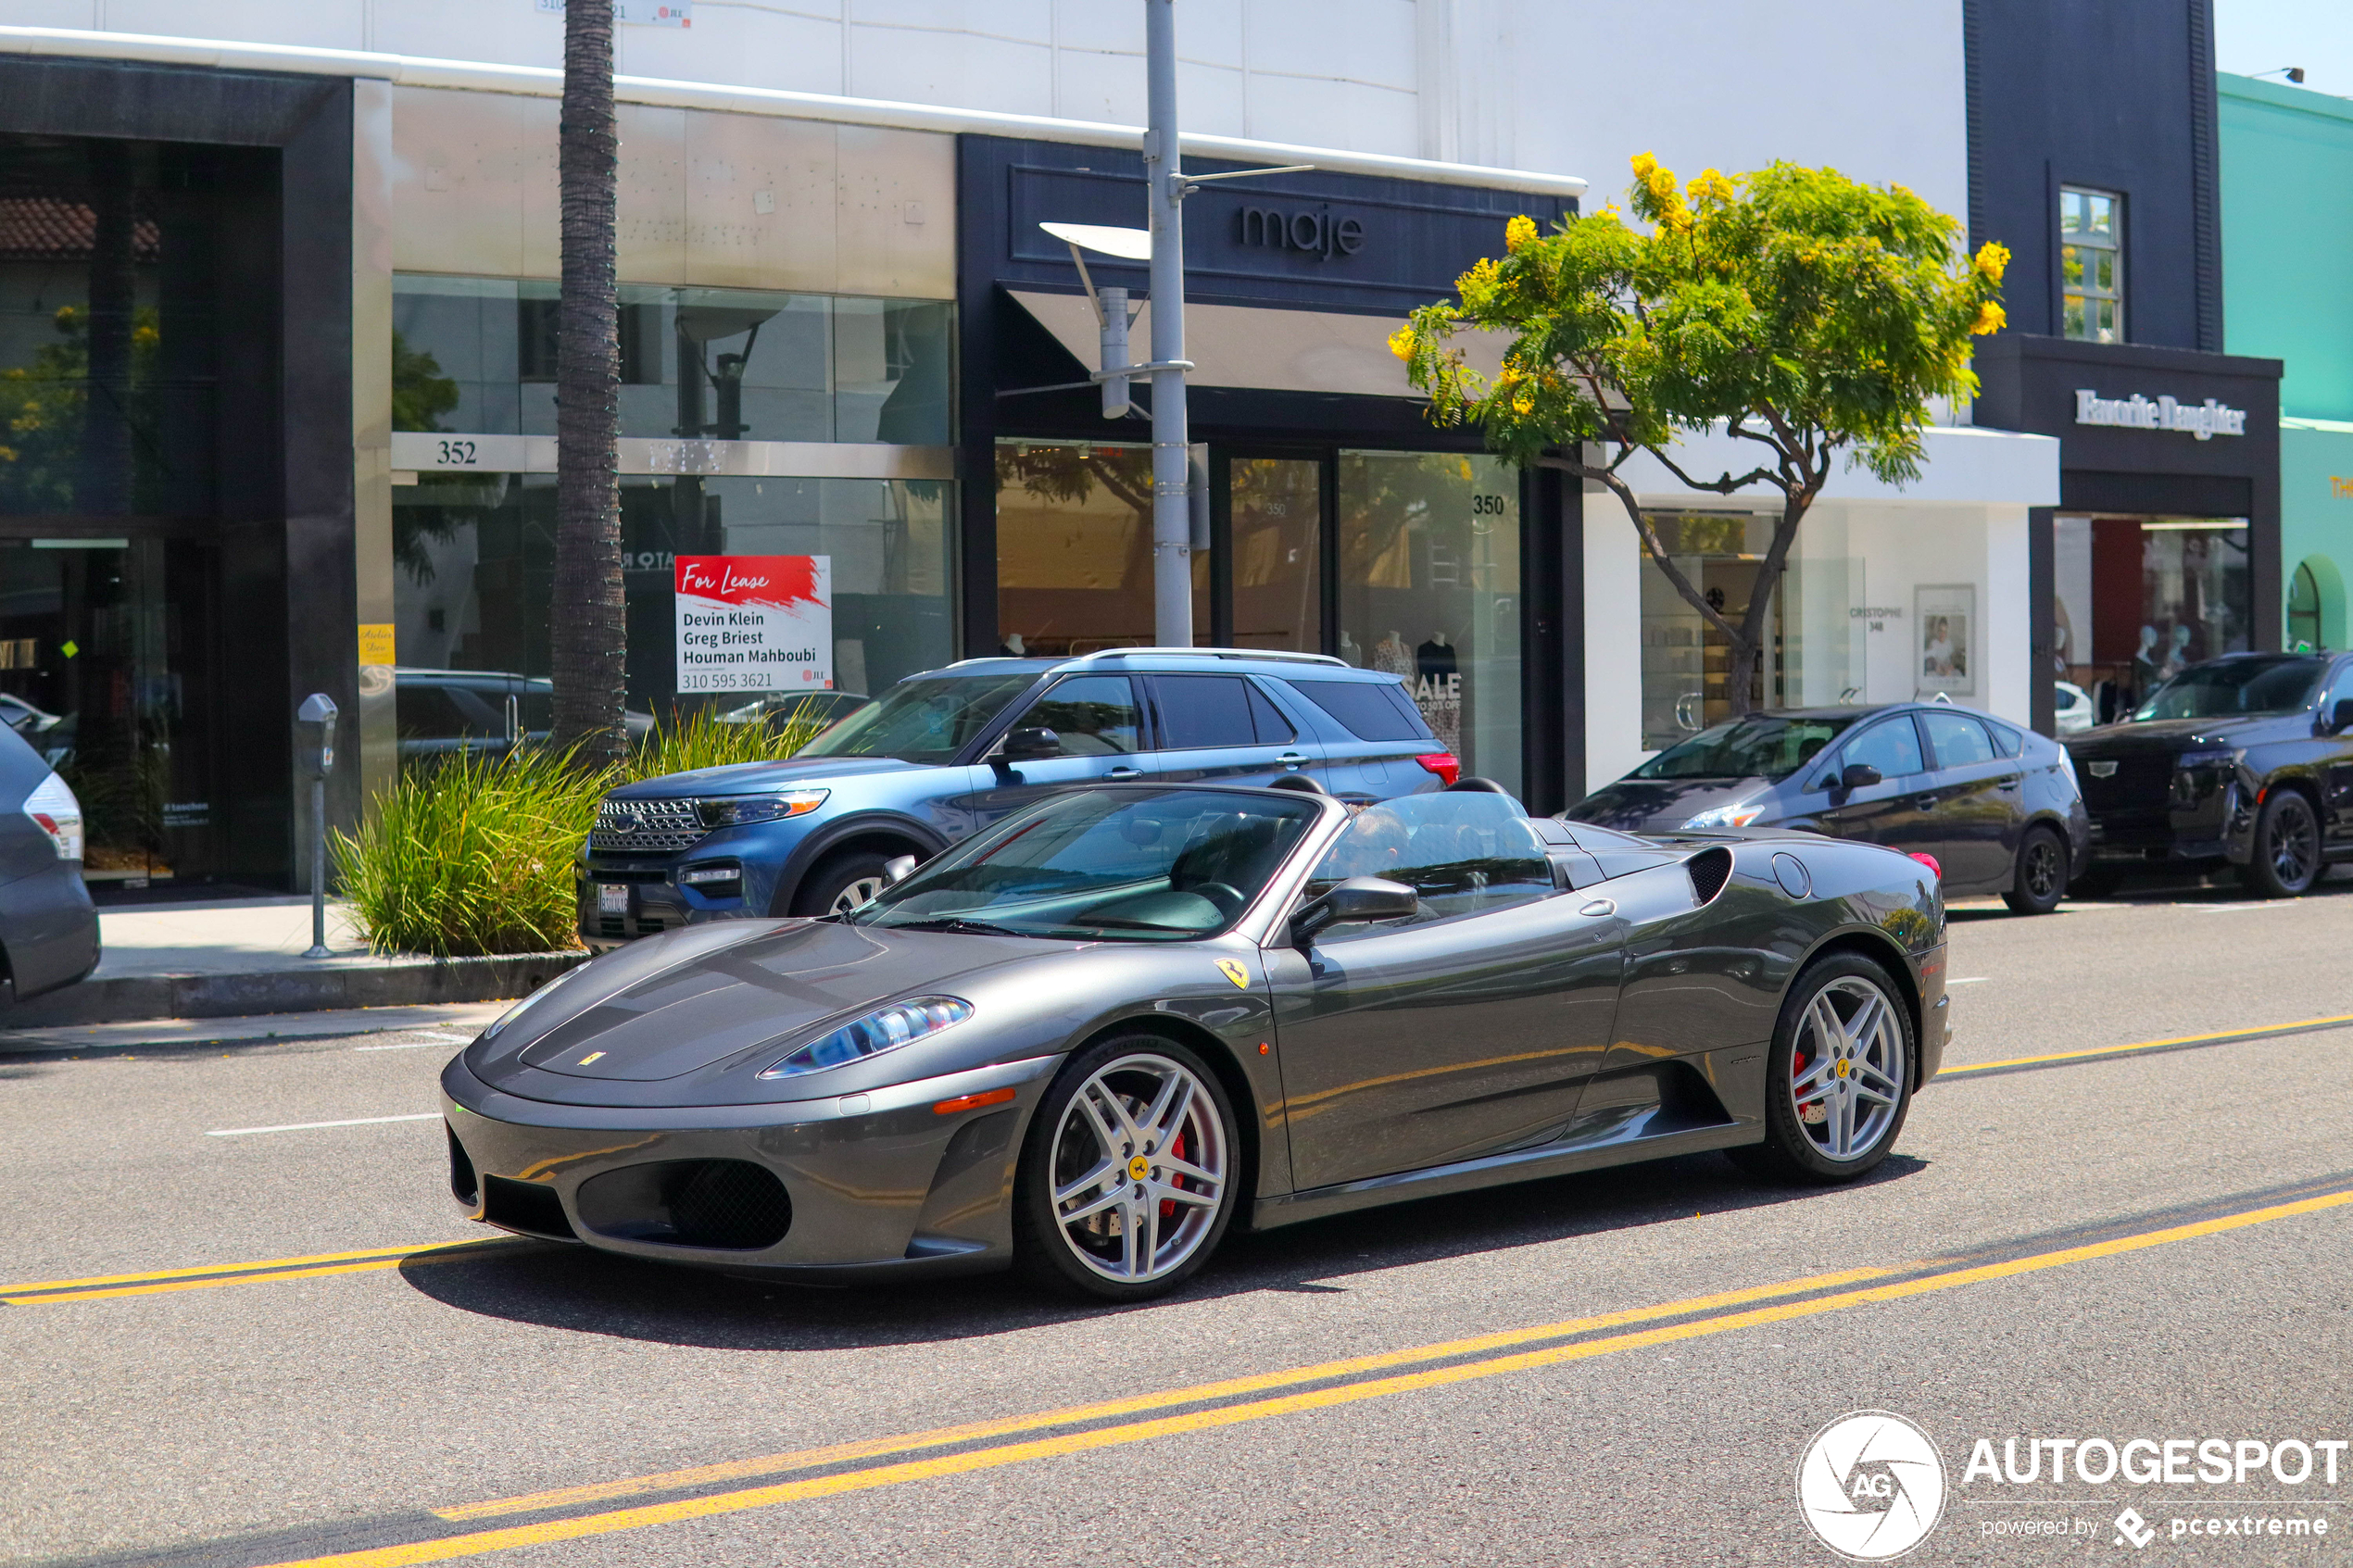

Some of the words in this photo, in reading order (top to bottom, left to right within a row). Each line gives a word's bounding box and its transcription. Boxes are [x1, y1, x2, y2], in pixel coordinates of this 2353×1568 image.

[1240, 203, 1368, 262] maje
[2075, 389, 2159, 430] Favorite
[2157, 395, 2247, 441] Daughter
[436, 440, 477, 464] 352
[1267, 503, 1287, 515] 350
[1473, 495, 1504, 515] 350
[682, 563, 717, 592] For
[720, 564, 770, 596] Lease
[684, 612, 724, 626] Devin
[729, 611, 764, 626] Klein
[1850, 607, 1903, 619] CRISTOPHE
[684, 632, 718, 648] Greg
[723, 630, 763, 645] Briest
[684, 651, 744, 664] Houman
[749, 647, 816, 663] Mahboubi
[683, 674, 708, 689] 310
[711, 674, 736, 688] 595
[740, 673, 773, 687] 3621
[1445, 700, 1461, 710] OFF
